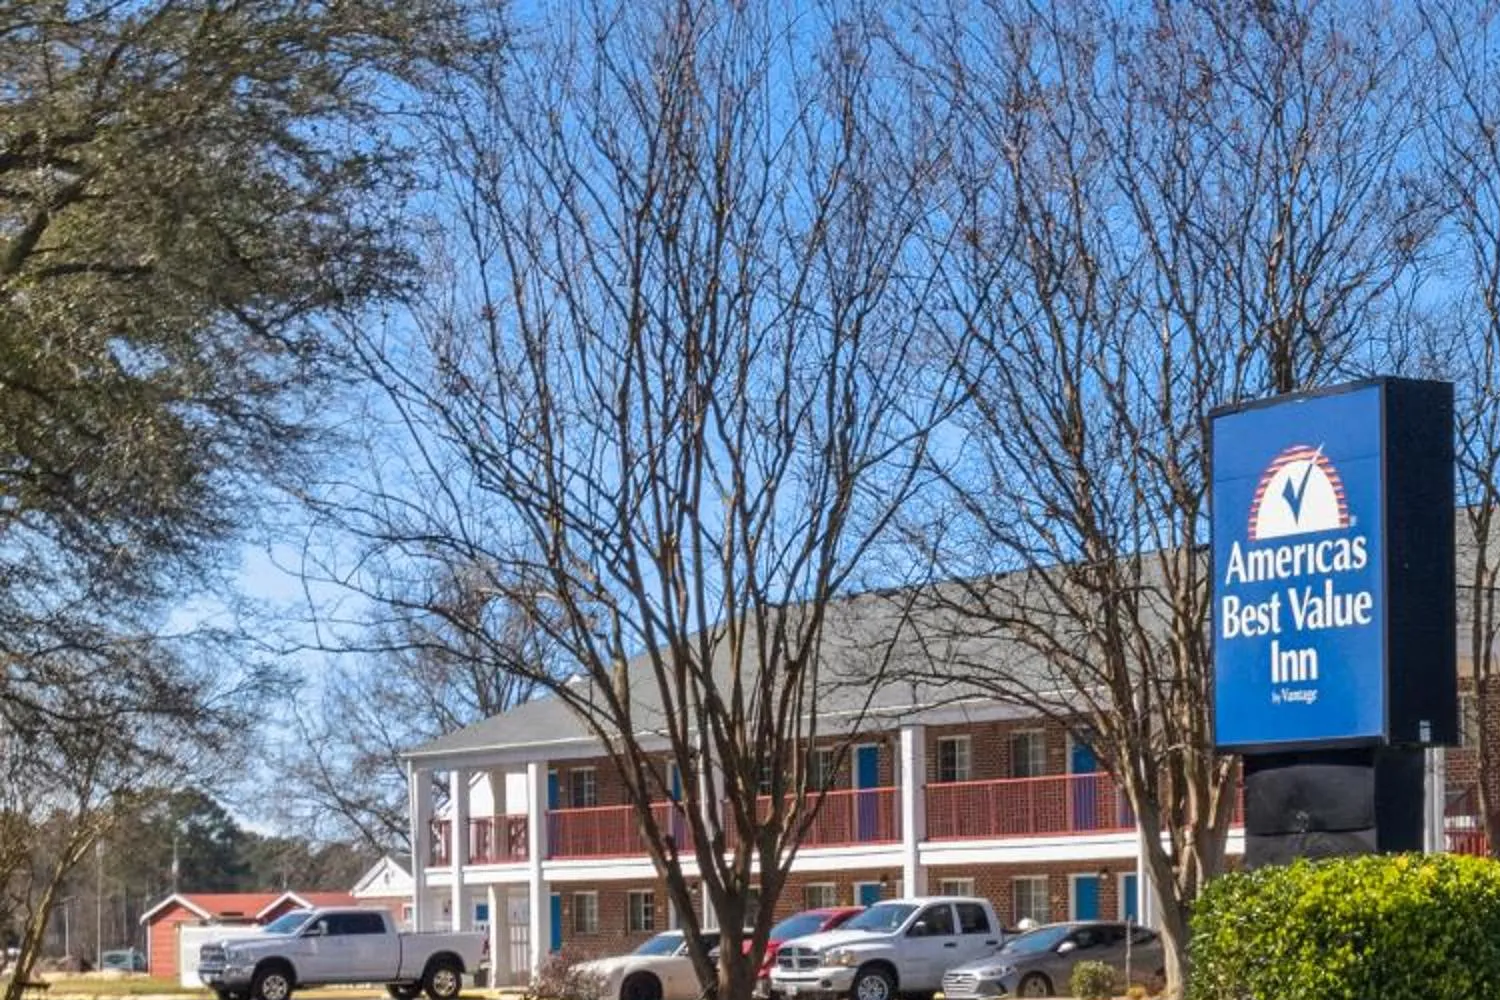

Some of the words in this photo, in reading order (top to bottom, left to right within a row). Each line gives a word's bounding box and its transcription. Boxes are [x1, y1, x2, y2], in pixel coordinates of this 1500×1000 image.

[1225, 535, 1367, 585] Americas
[1222, 591, 1282, 640] Best
[1287, 578, 1373, 632] Value
[1271, 639, 1319, 684] Inn
